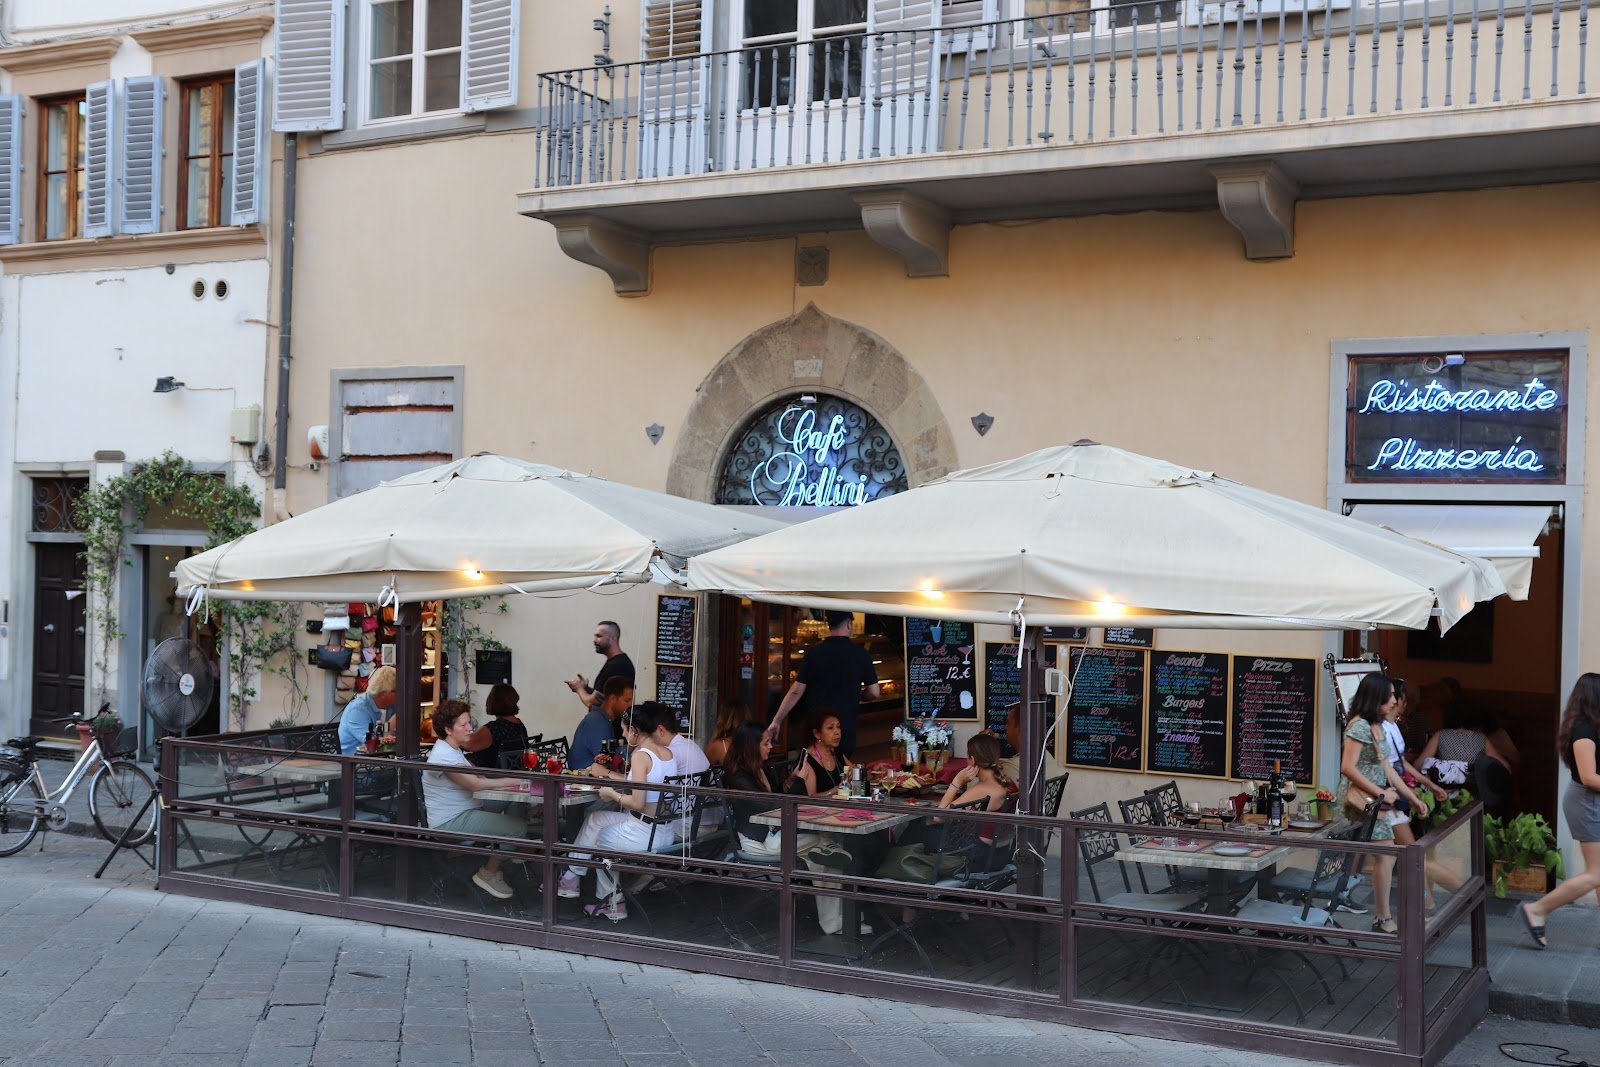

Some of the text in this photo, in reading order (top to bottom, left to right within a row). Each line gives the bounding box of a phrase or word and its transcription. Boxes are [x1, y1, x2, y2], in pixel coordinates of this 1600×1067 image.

[1359, 377, 1558, 414] Ristorante
[750, 451, 869, 507] Bellini
[1166, 653, 1206, 668] Secondi
[1162, 695, 1205, 711] Burgers
